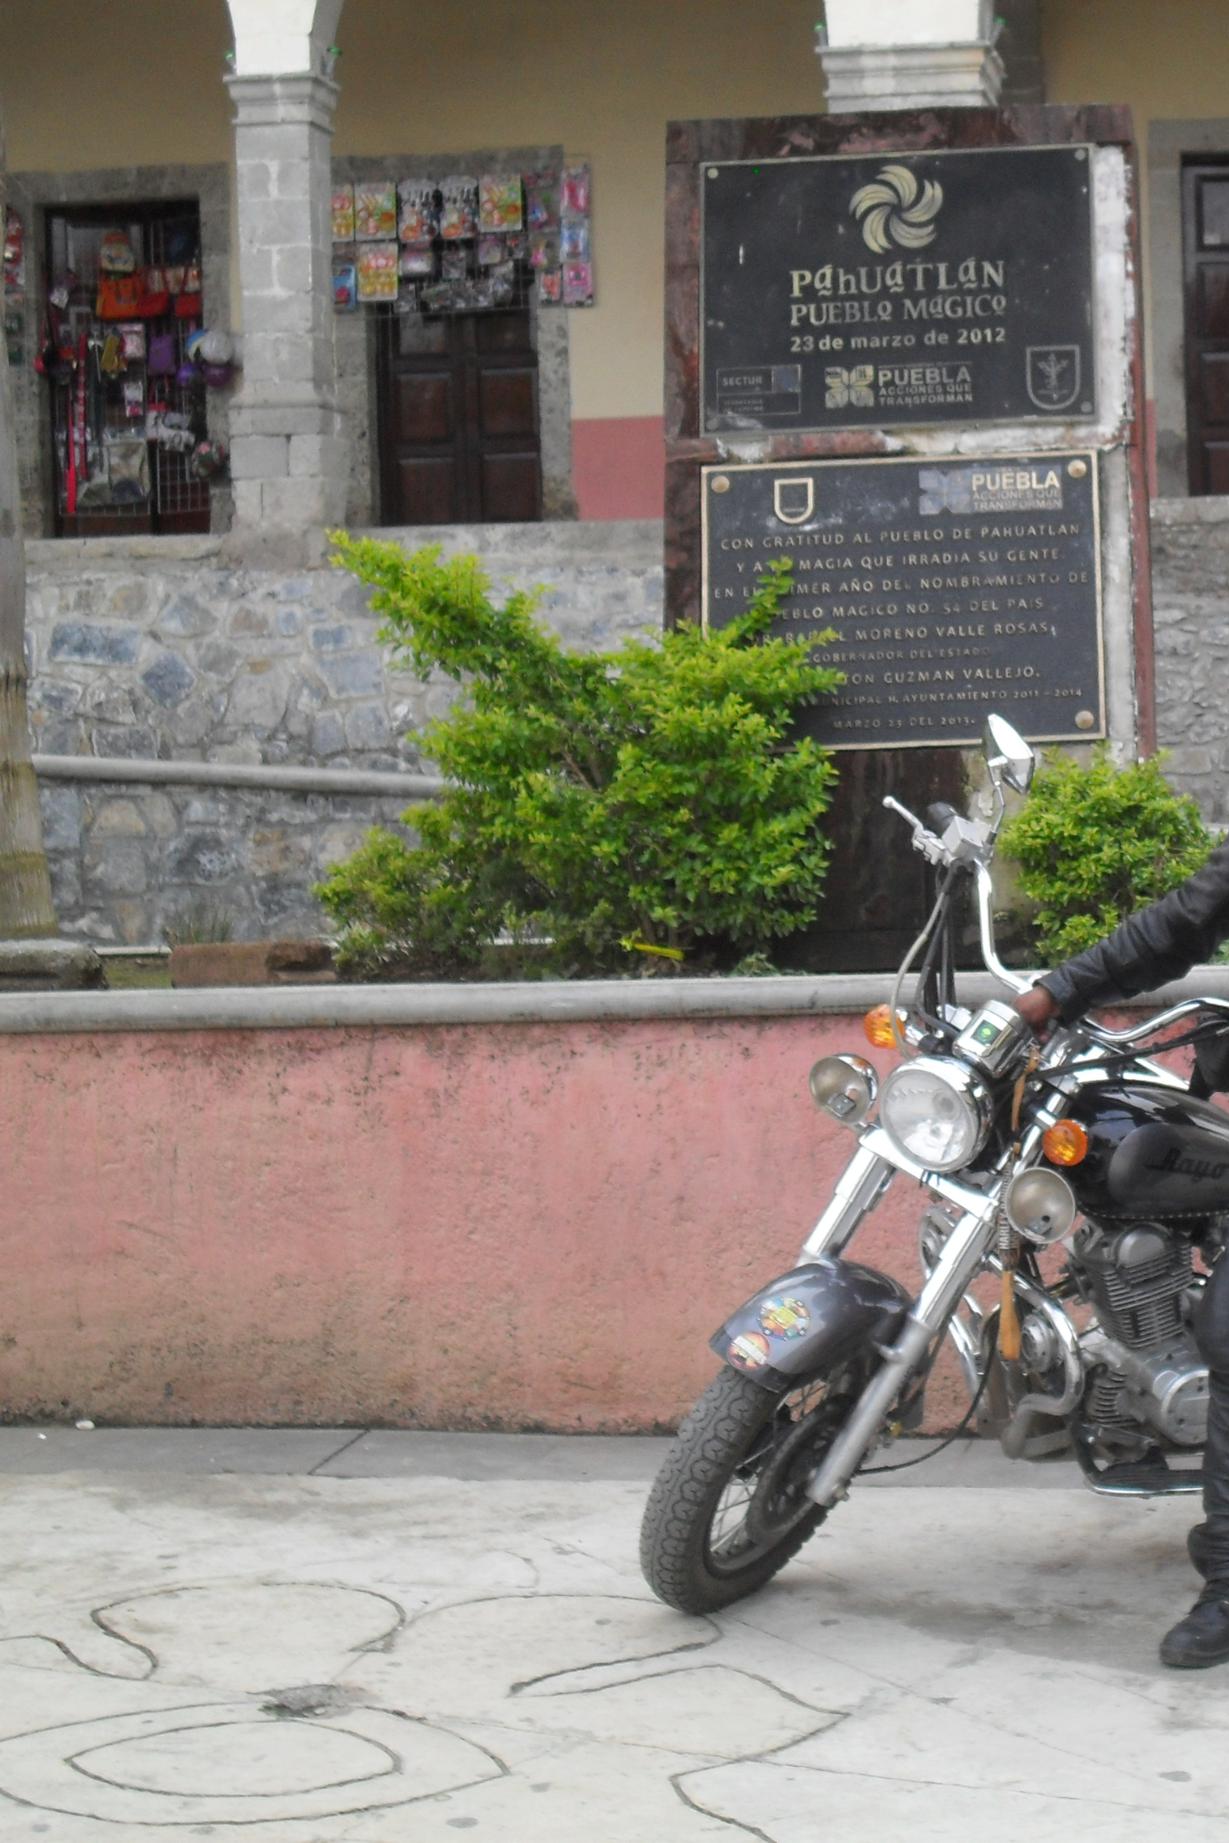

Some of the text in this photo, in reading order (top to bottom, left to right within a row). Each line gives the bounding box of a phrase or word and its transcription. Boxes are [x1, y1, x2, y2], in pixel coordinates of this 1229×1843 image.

[790, 328, 1006, 352] 23 de marzo de 2012
[722, 375, 763, 387] SECTUR
[878, 365, 972, 387] PUEBLA
[879, 383, 972, 397] ACCIONES QUE
[879, 394, 973, 407] TRANSFORMAN
[972, 470, 1060, 491] PUEBLA
[721, 524, 1080, 550] CON GRATITUD AL PUEBLO DE PAHUATLAN
[737, 562, 744, 573] Y
[753, 561, 763, 572] A
[799, 558, 853, 570] MAGIA
[861, 556, 893, 570] QUE
[903, 552, 970, 565] IRRADIA
[979, 551, 998, 562] SU
[715, 587, 734, 599] EN
[839, 577, 874, 592] AÑO
[882, 579, 911, 591] DEL
[920, 573, 1060, 590] NOMBRAMIENTO
[1068, 571, 1089, 583] DE
[832, 604, 897, 618] MAGICO
[970, 600, 999, 612] DEL
[855, 626, 928, 641] MORENO
[936, 624, 985, 638] VALLE
[812, 648, 990, 663] GOBERNADOR DEL ESTADO
[884, 669, 954, 684] GUZMAN
[903, 690, 1008, 704] AYUNTAMIENTO
[1013, 689, 1040, 699] 2011
[1054, 688, 1082, 697] 2014
[833, 718, 881, 729] MARZO
[910, 717, 933, 727] DEL
